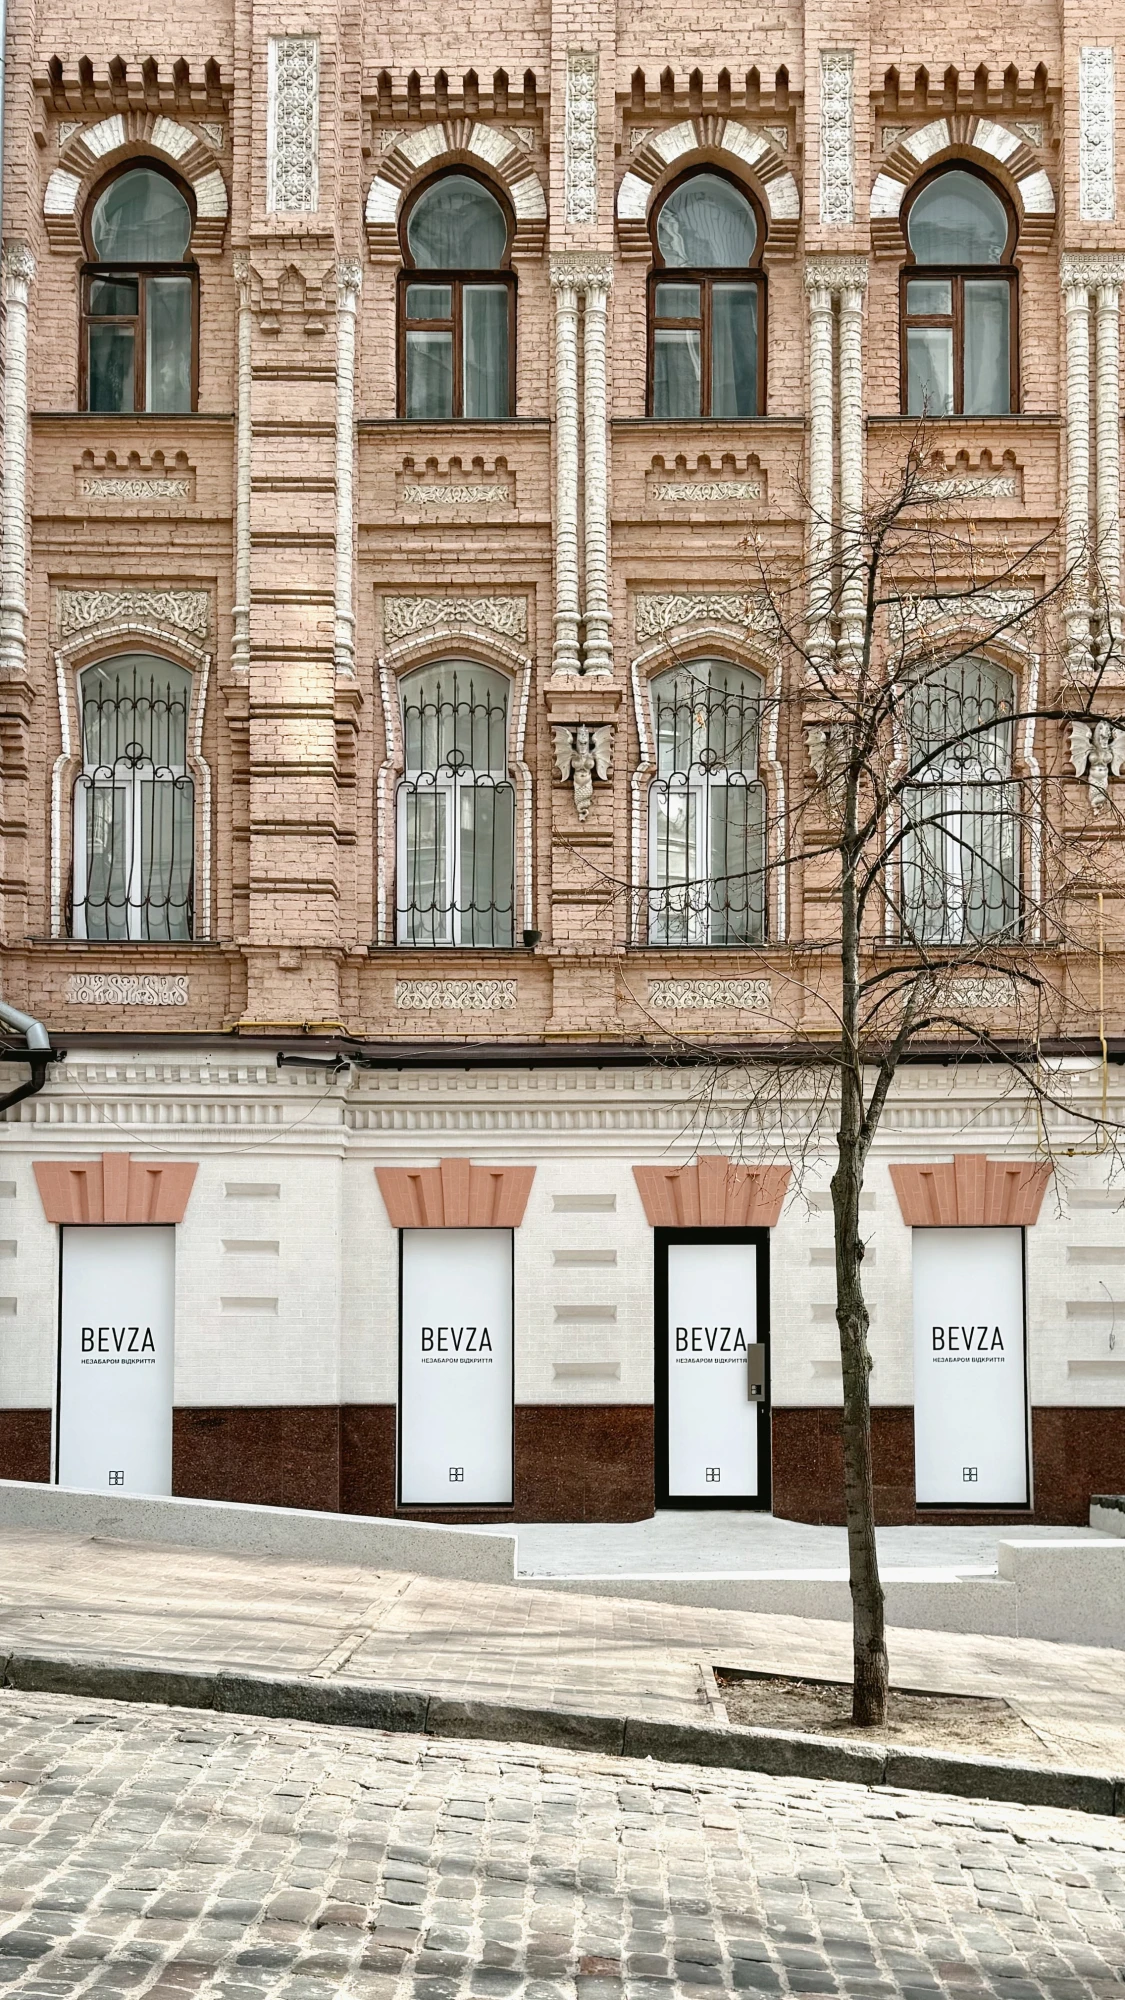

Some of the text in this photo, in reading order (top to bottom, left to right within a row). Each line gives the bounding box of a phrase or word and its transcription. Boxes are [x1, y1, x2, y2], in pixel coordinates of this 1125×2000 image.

[82, 1327, 155, 1352] BEVZA
[421, 1327, 492, 1351] BEVZA
[676, 1327, 747, 1352] BEVZA
[933, 1326, 1004, 1351] BEVZA
